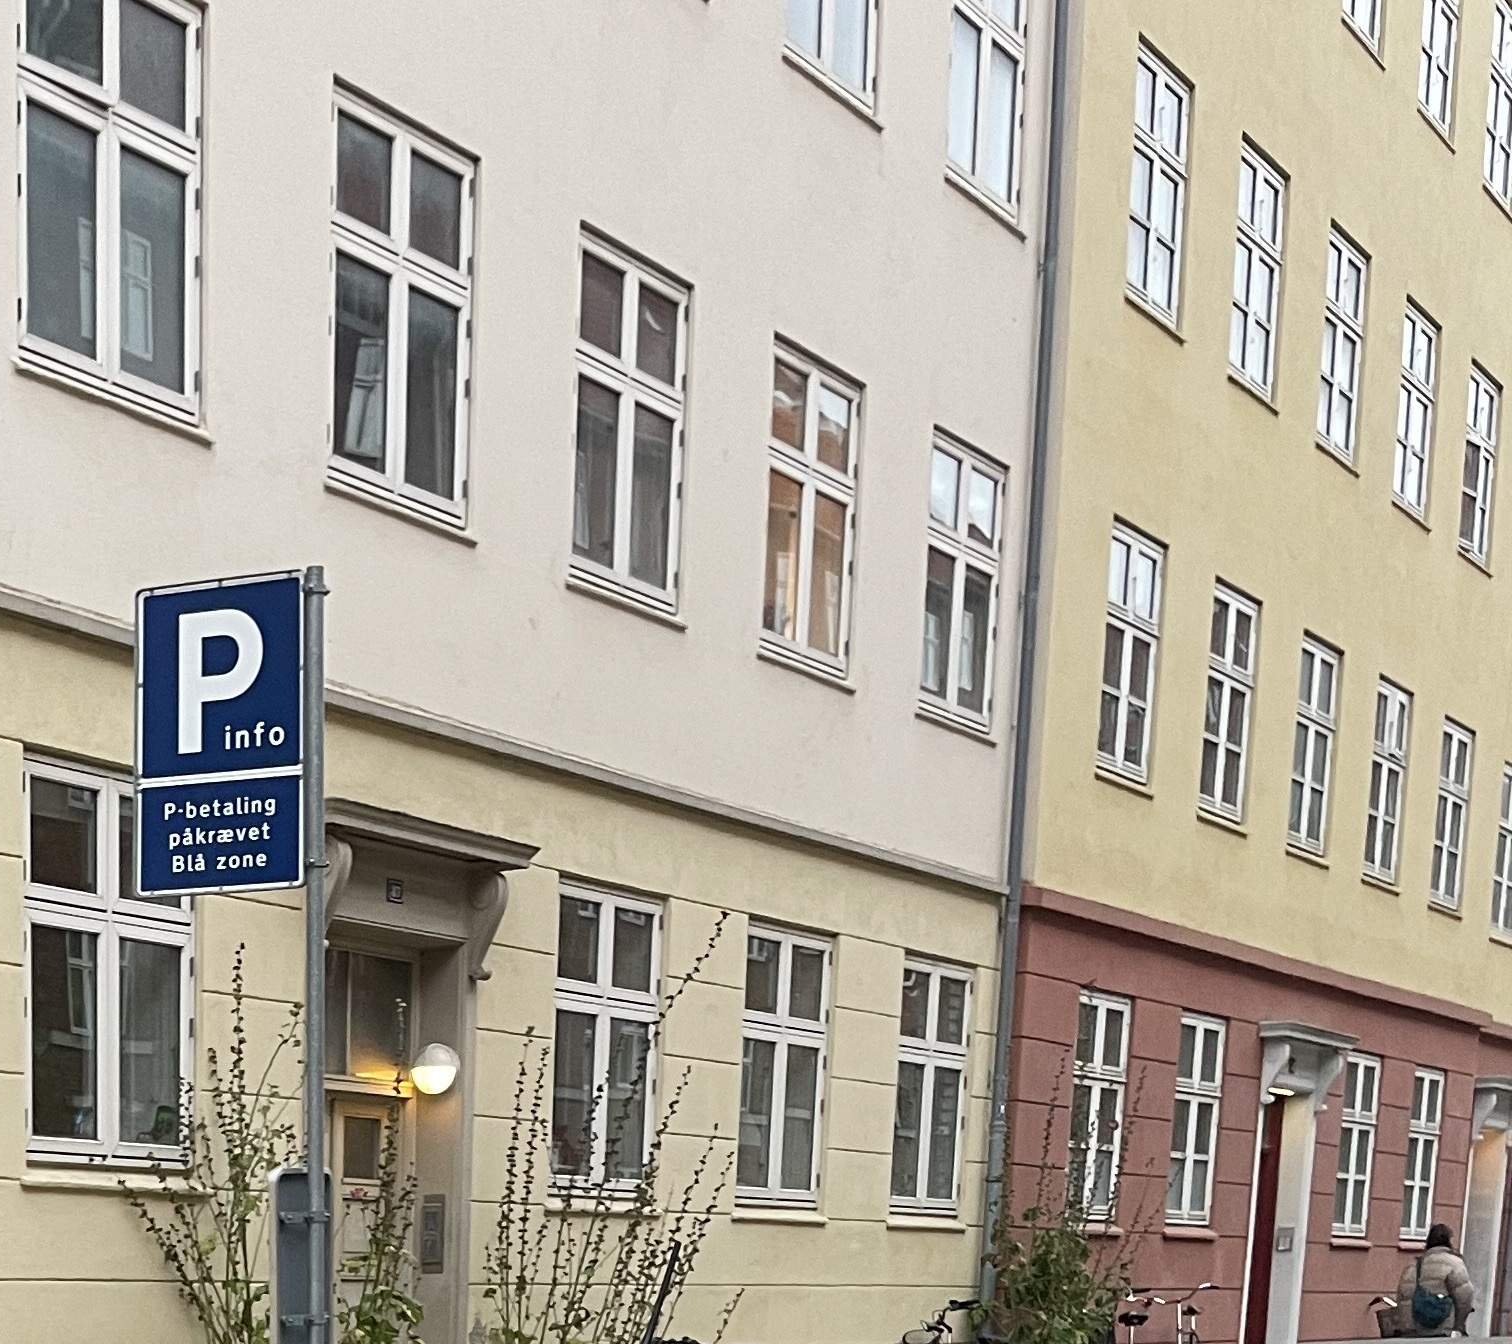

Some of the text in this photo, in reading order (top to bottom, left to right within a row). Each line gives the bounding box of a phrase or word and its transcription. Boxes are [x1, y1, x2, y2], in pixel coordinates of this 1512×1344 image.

[178, 608, 263, 754] P
[224, 722, 286, 751] info
[163, 797, 277, 821] P-betaling
[168, 822, 271, 850] påkrævet
[171, 853, 268, 874] Blå zone
